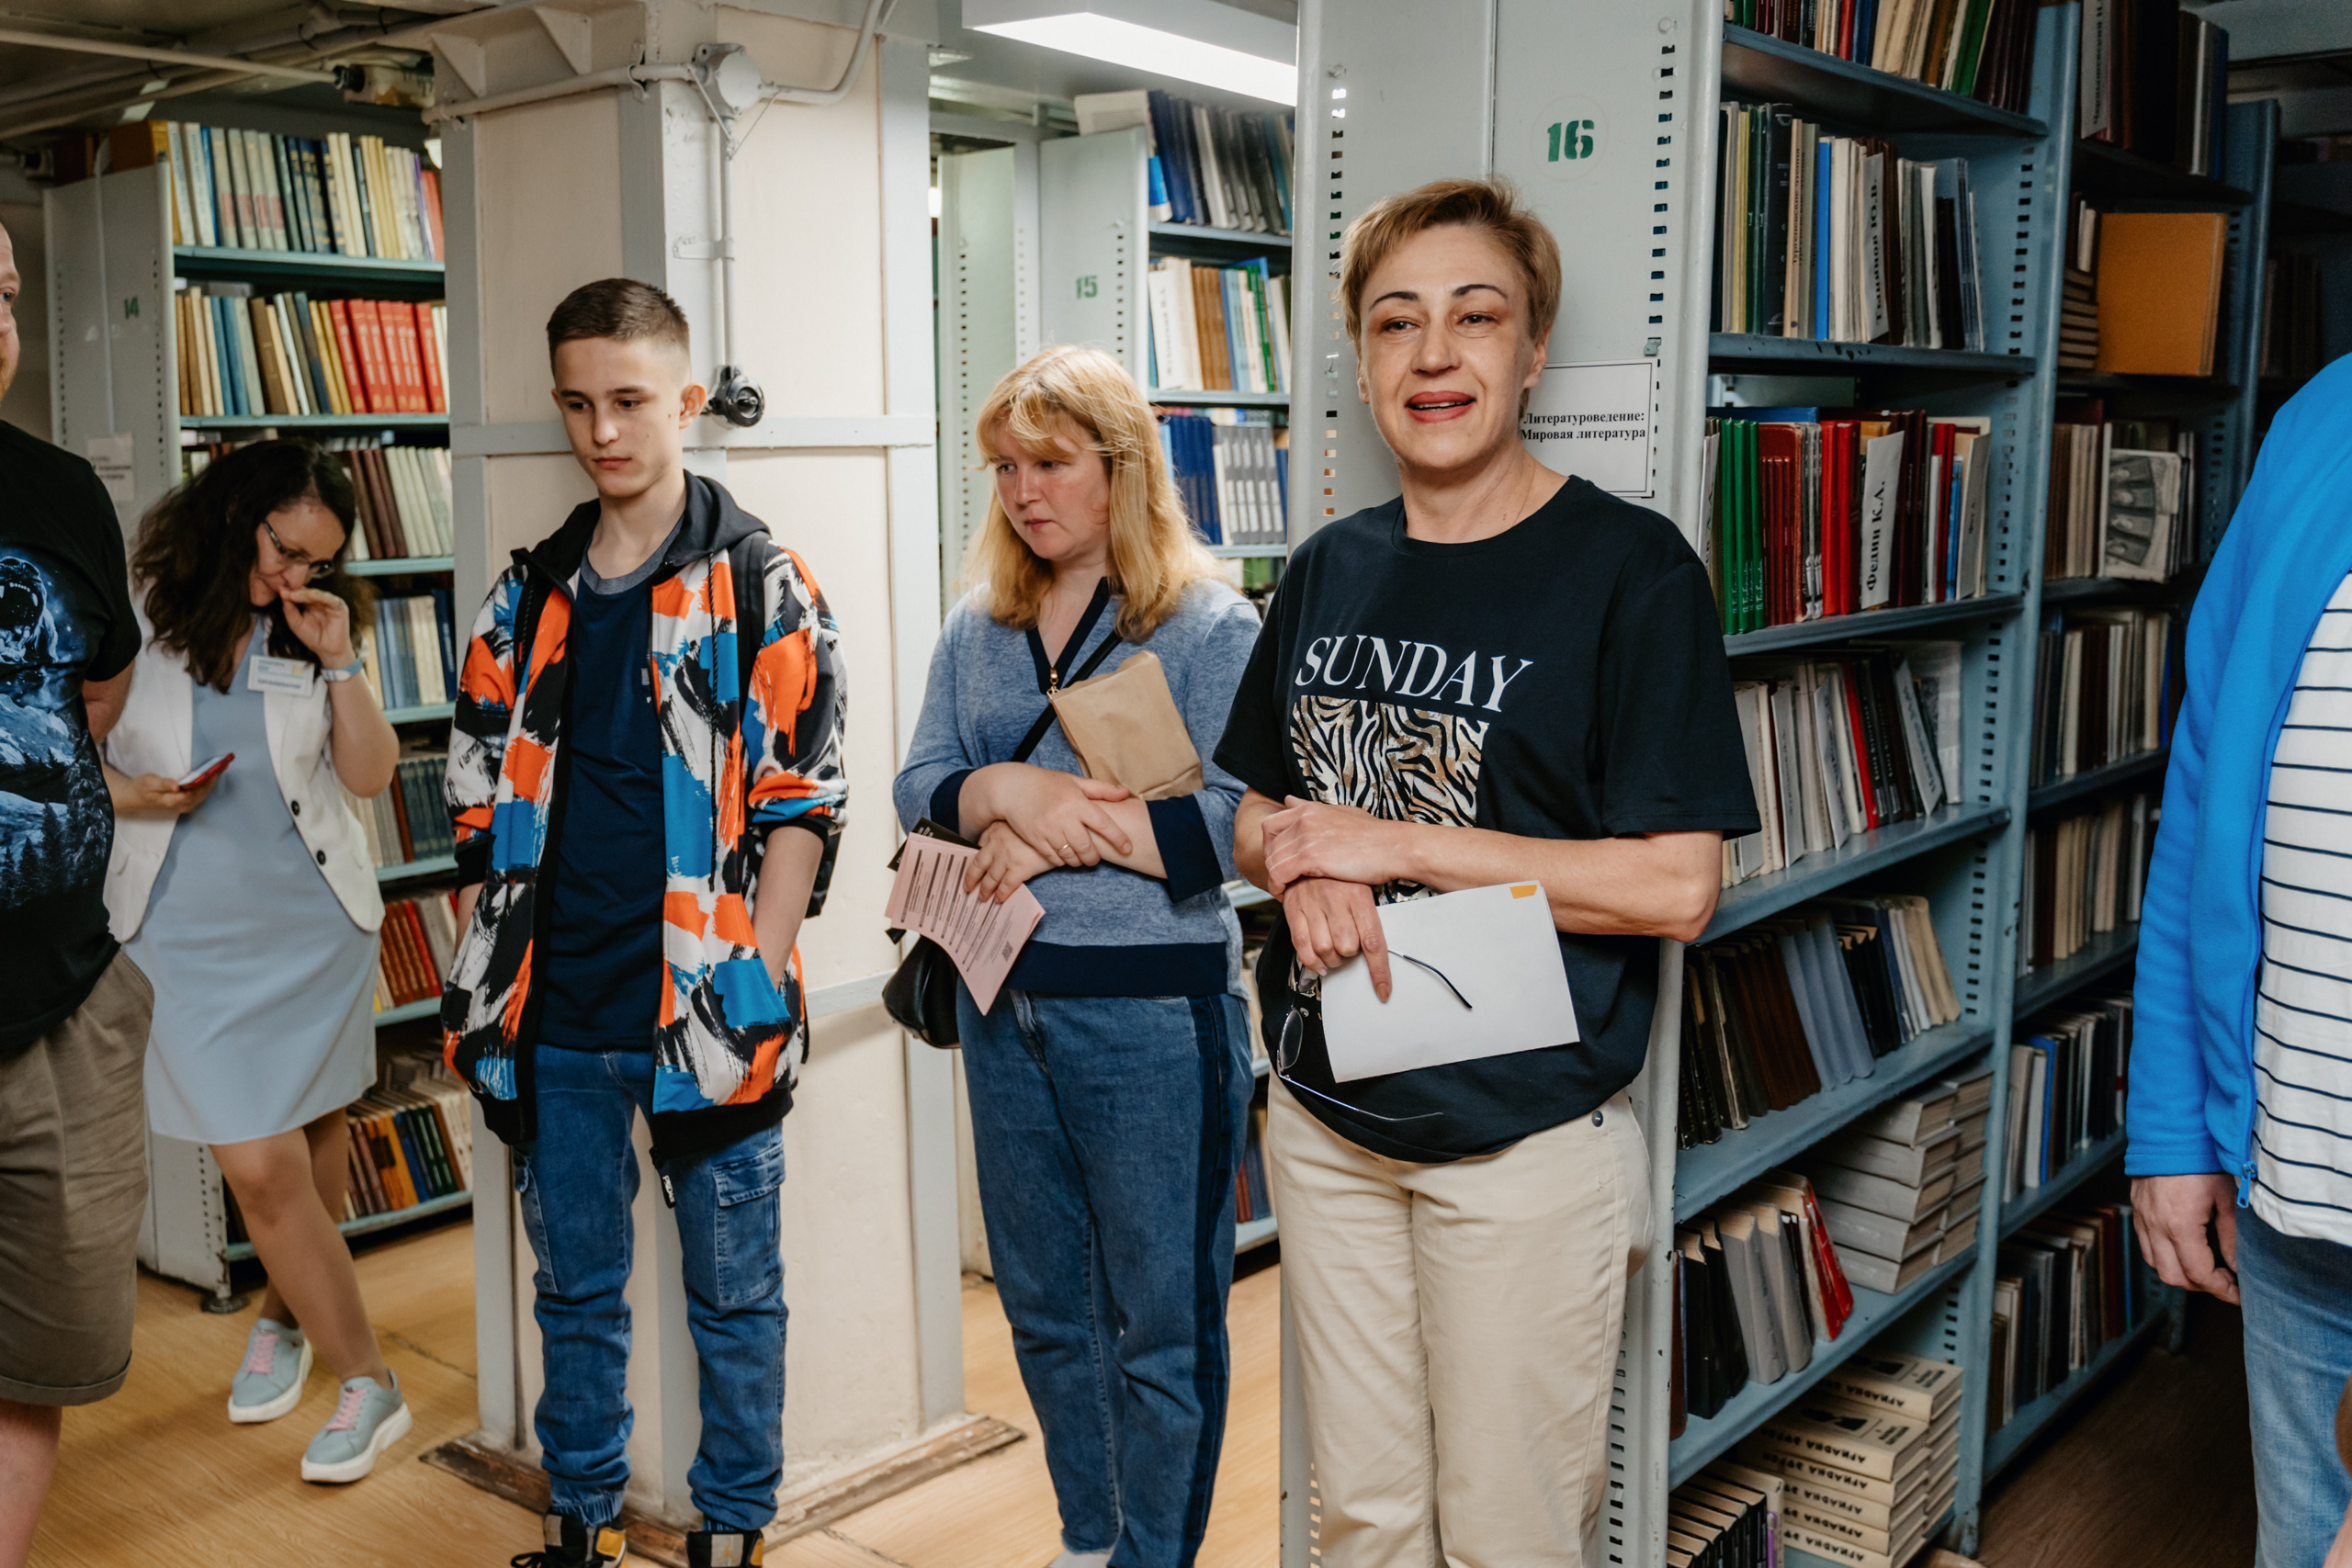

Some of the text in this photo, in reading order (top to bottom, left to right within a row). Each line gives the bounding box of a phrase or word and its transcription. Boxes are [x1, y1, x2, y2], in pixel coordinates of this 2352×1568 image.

[1547, 119, 1595, 163] 16
[1076, 275, 1098, 300] 15
[1871, 234, 1883, 325] Тынянов
[124, 297, 139, 320] 14
[1521, 428, 1645, 443] Мировая литература
[1523, 412, 1645, 426] Литературоведение:
[1866, 480, 1885, 591] Федин К.А.
[1295, 634, 1533, 713] SUNDAY
